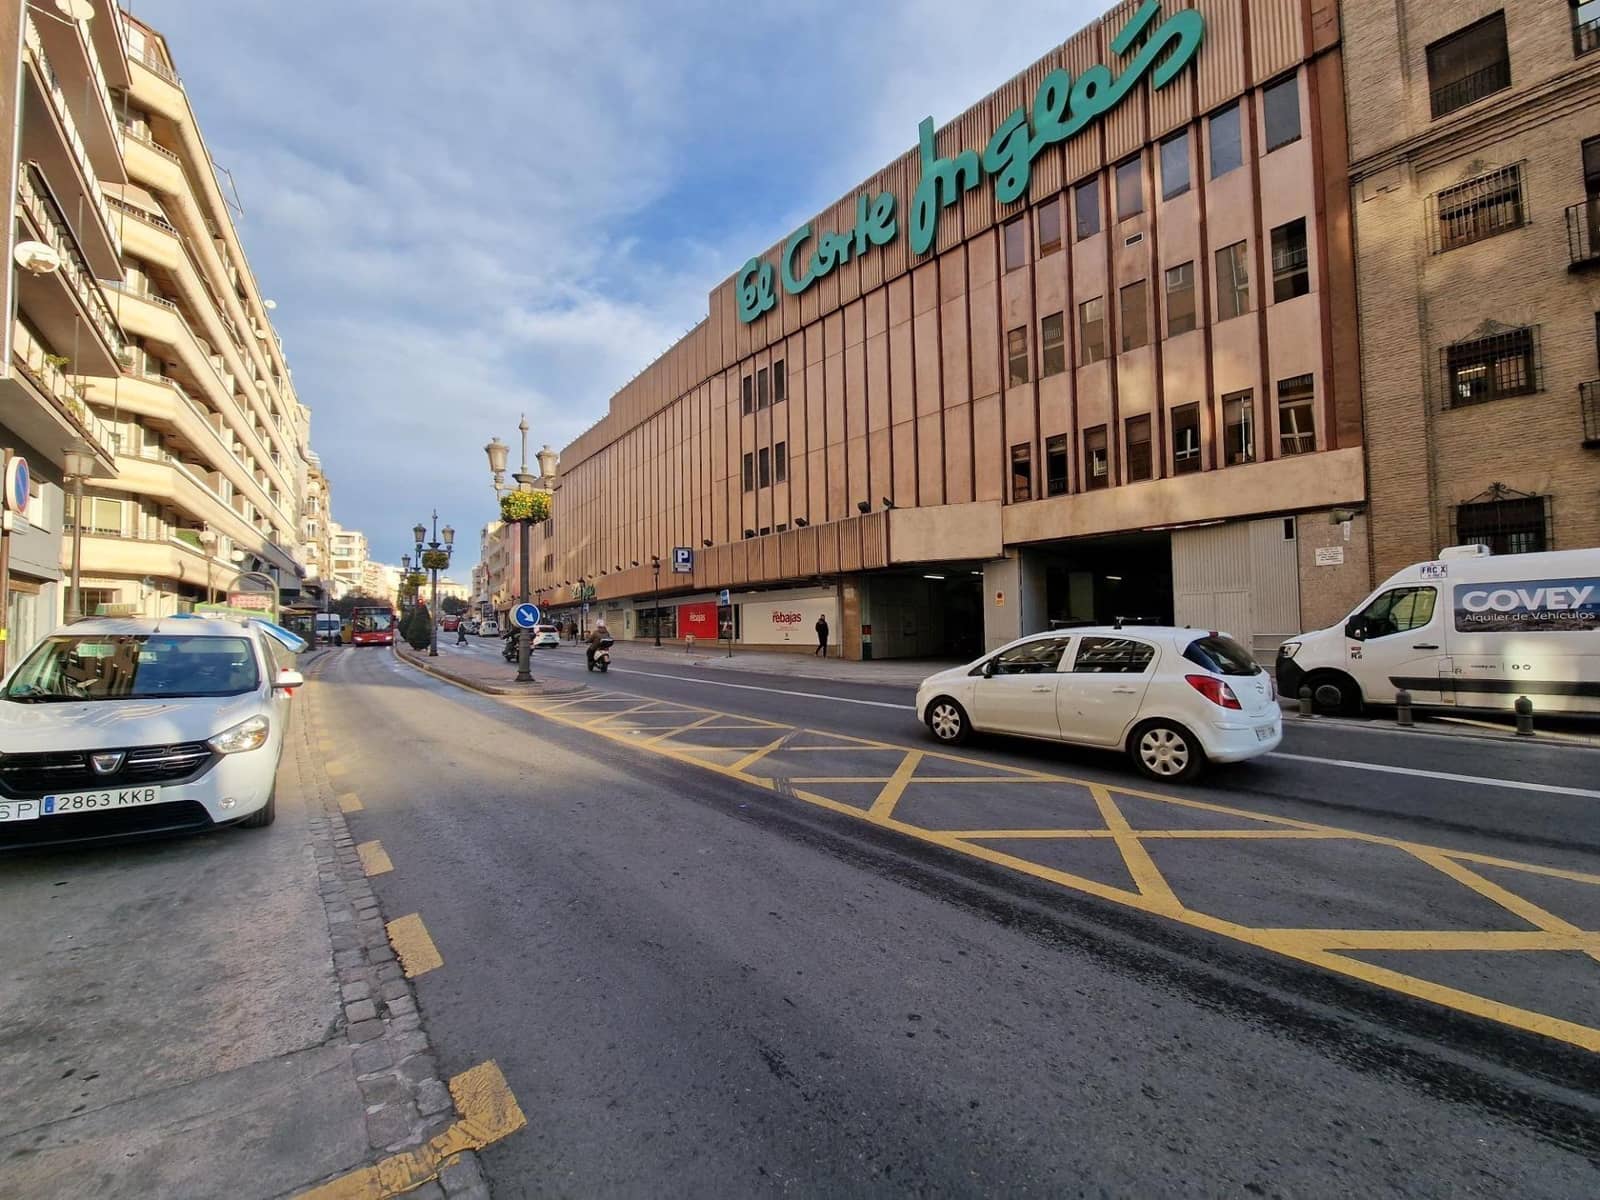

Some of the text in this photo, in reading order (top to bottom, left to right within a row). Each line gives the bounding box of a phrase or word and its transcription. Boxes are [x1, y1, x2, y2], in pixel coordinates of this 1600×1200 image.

[736, 256, 778, 325] El
[781, 191, 898, 295] Corte
[1462, 585, 1594, 612] COVEY
[772, 612, 802, 625] rebajas
[1465, 610, 1596, 623] Alquiler de Vehículos
[59, 789, 156, 811] 2863 KKB
[0, 803, 33, 819] SP
